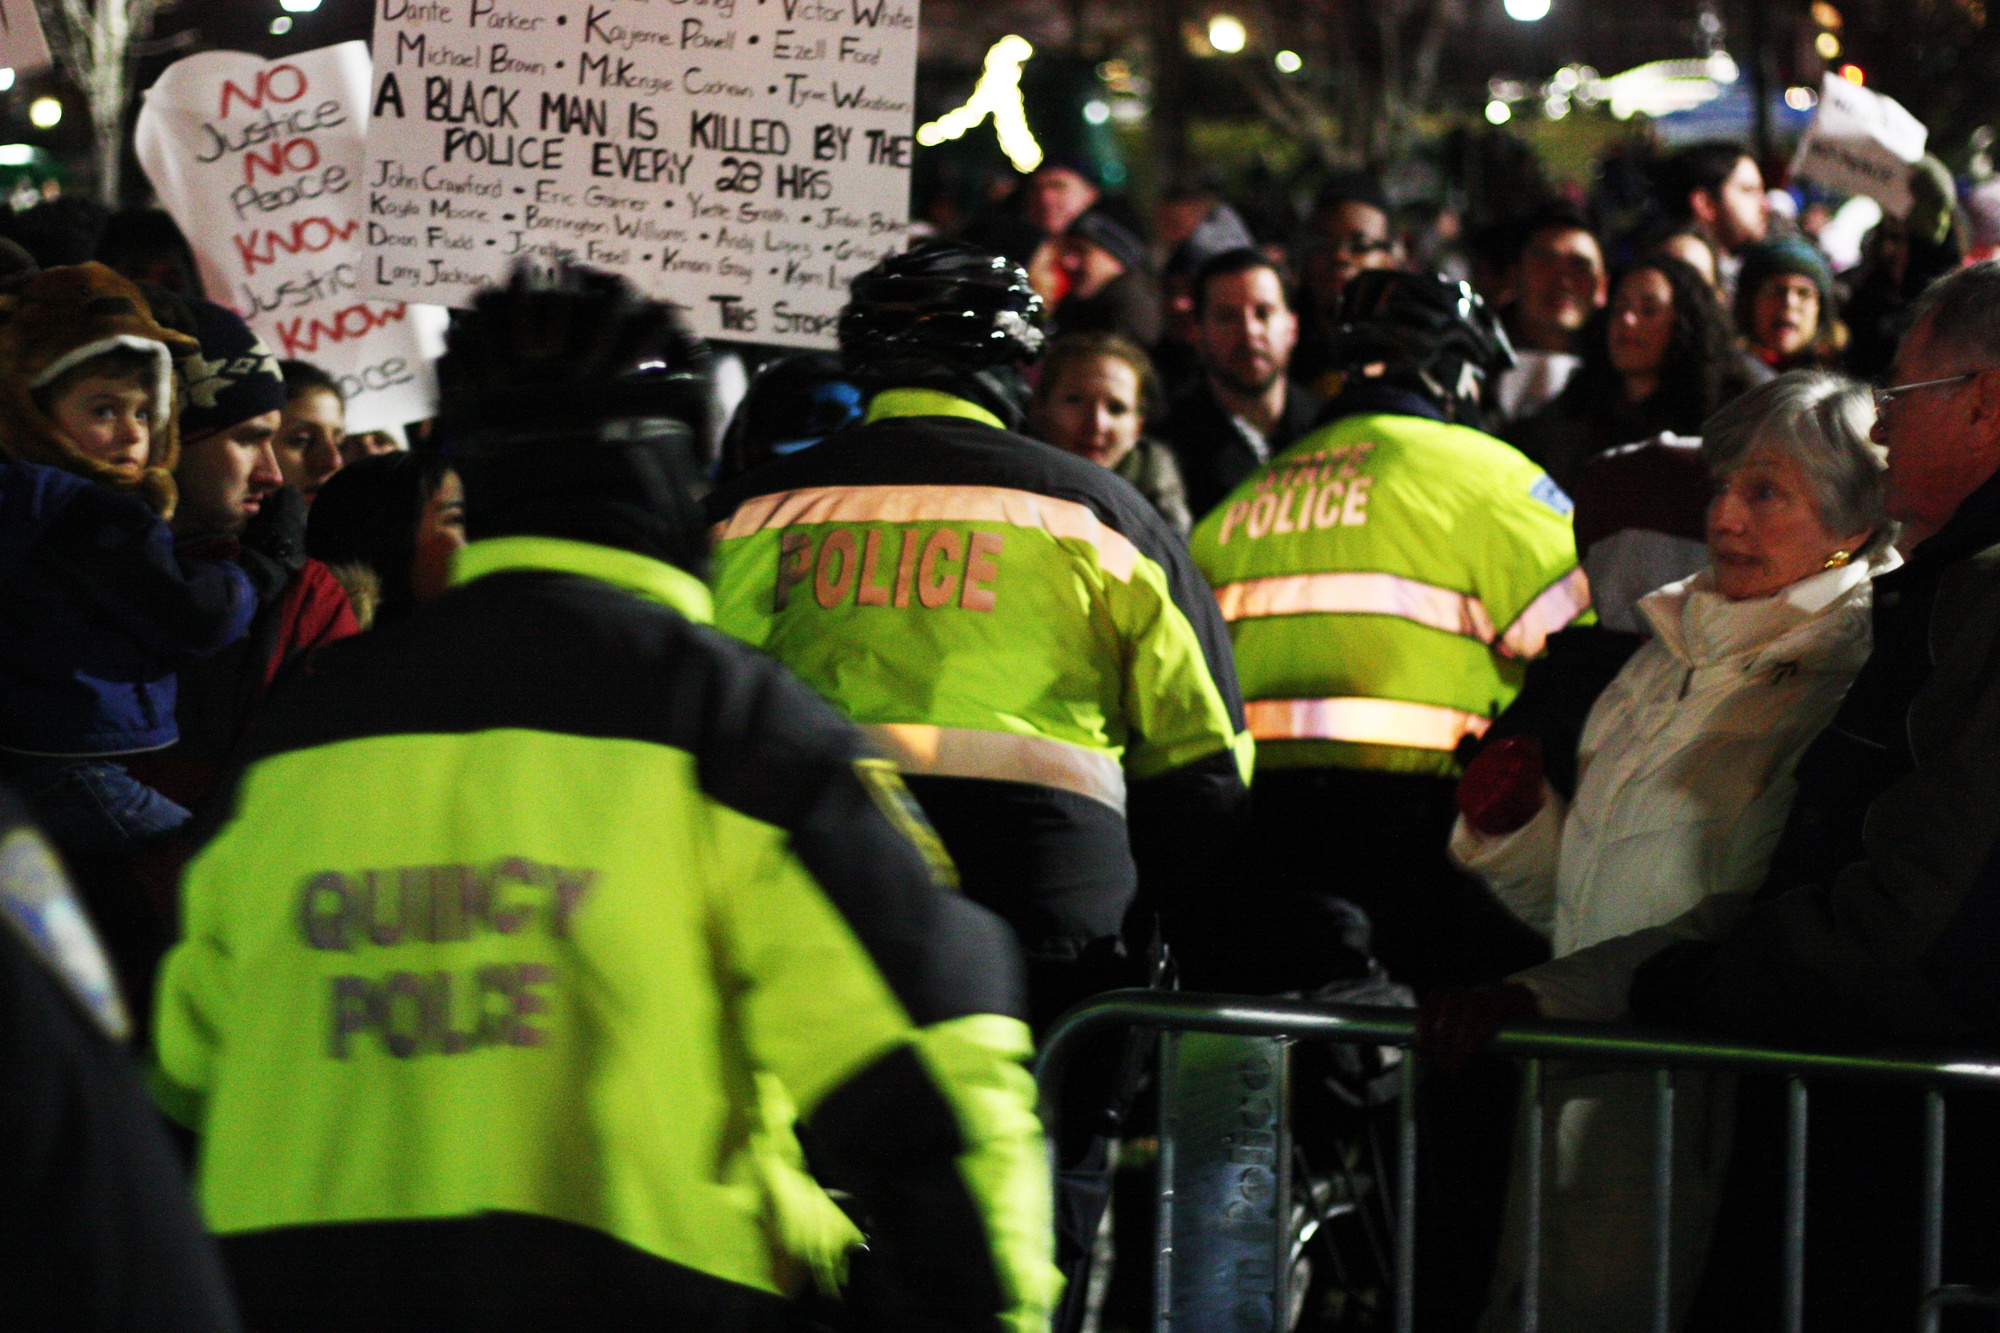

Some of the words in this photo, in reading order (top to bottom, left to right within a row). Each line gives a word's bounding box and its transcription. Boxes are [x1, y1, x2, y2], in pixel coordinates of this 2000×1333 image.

[397, 31, 480, 68] Michael
[490, 44, 546, 75] Brown
[218, 64, 309, 120] NO
[374, 72, 405, 118] A
[425, 75, 521, 128] BLACK
[540, 91, 607, 137] MAN
[628, 102, 659, 141] IS
[690, 109, 790, 155] KILLED
[814, 123, 853, 161] BY
[865, 129, 914, 168] THE
[195, 100, 347, 163] Justice
[243, 138, 320, 185] NO
[443, 127, 566, 170] POLICE
[592, 141, 694, 186] EVERY
[715, 156, 763, 194] 28
[776, 164, 833, 200] HRS
[230, 165, 351, 220] Peace
[239, 263, 357, 320] Justic
[276, 301, 407, 359] KNOW
[1218, 477, 1373, 546] POLICE
[774, 527, 1004, 613] POLICE
